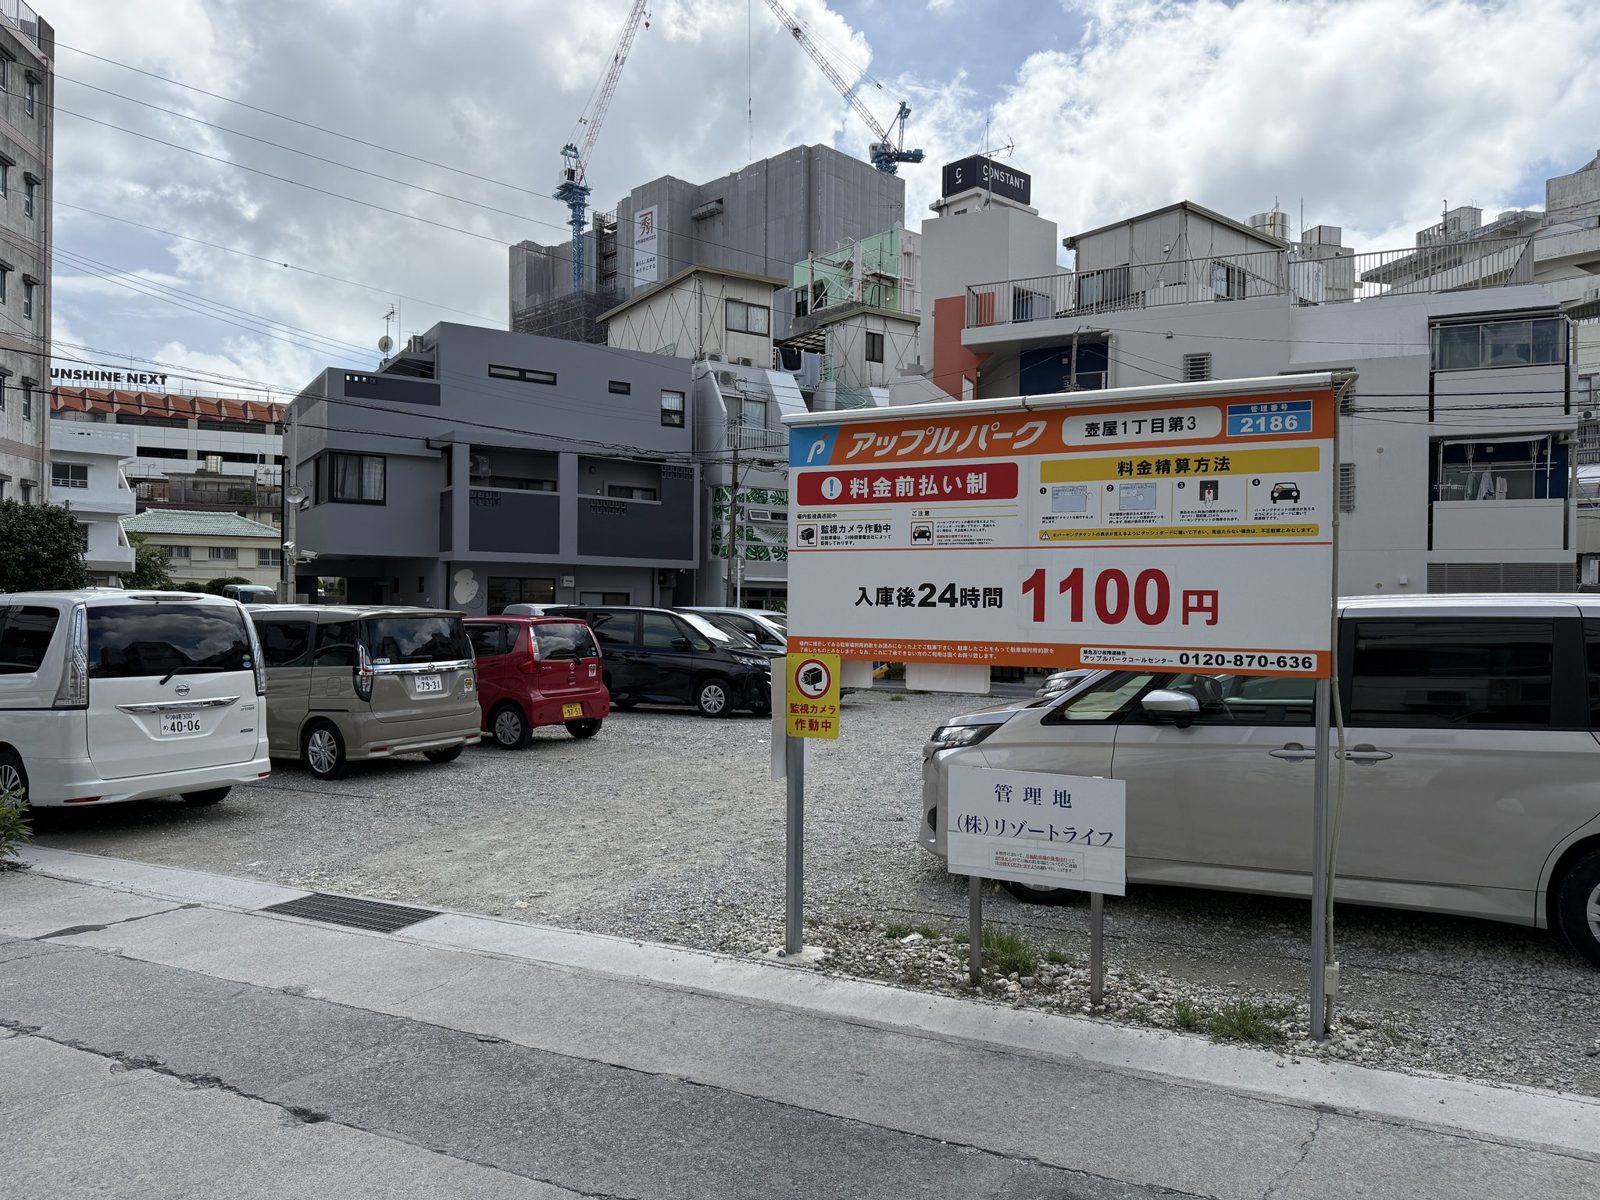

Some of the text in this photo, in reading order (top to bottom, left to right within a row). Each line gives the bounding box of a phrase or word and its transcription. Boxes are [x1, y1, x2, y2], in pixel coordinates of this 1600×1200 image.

[982, 165, 1024, 190] CONSTANT
[127, 373, 168, 385] NEXT
[1250, 404, 1289, 413] 管理番号
[1240, 414, 1299, 433] 2186
[846, 421, 1048, 459] アップルパーク
[1117, 456, 1231, 476] 料金精算方法
[849, 472, 988, 499] 料金前払い制
[820, 523, 892, 534] 監視カメラ作動中
[854, 582, 1003, 609] 入庫後24時間
[1083, 655, 1174, 664] アップルパークコールセンター
[1179, 652, 1313, 669] 0120-870-636
[789, 703, 837, 715] 監視カメラ
[170, 720, 200, 733] 40-06
[795, 718, 832, 732] 作動中
[994, 783, 1073, 809] 管理地
[957, 813, 1114, 847] (株)リゾートライフ
